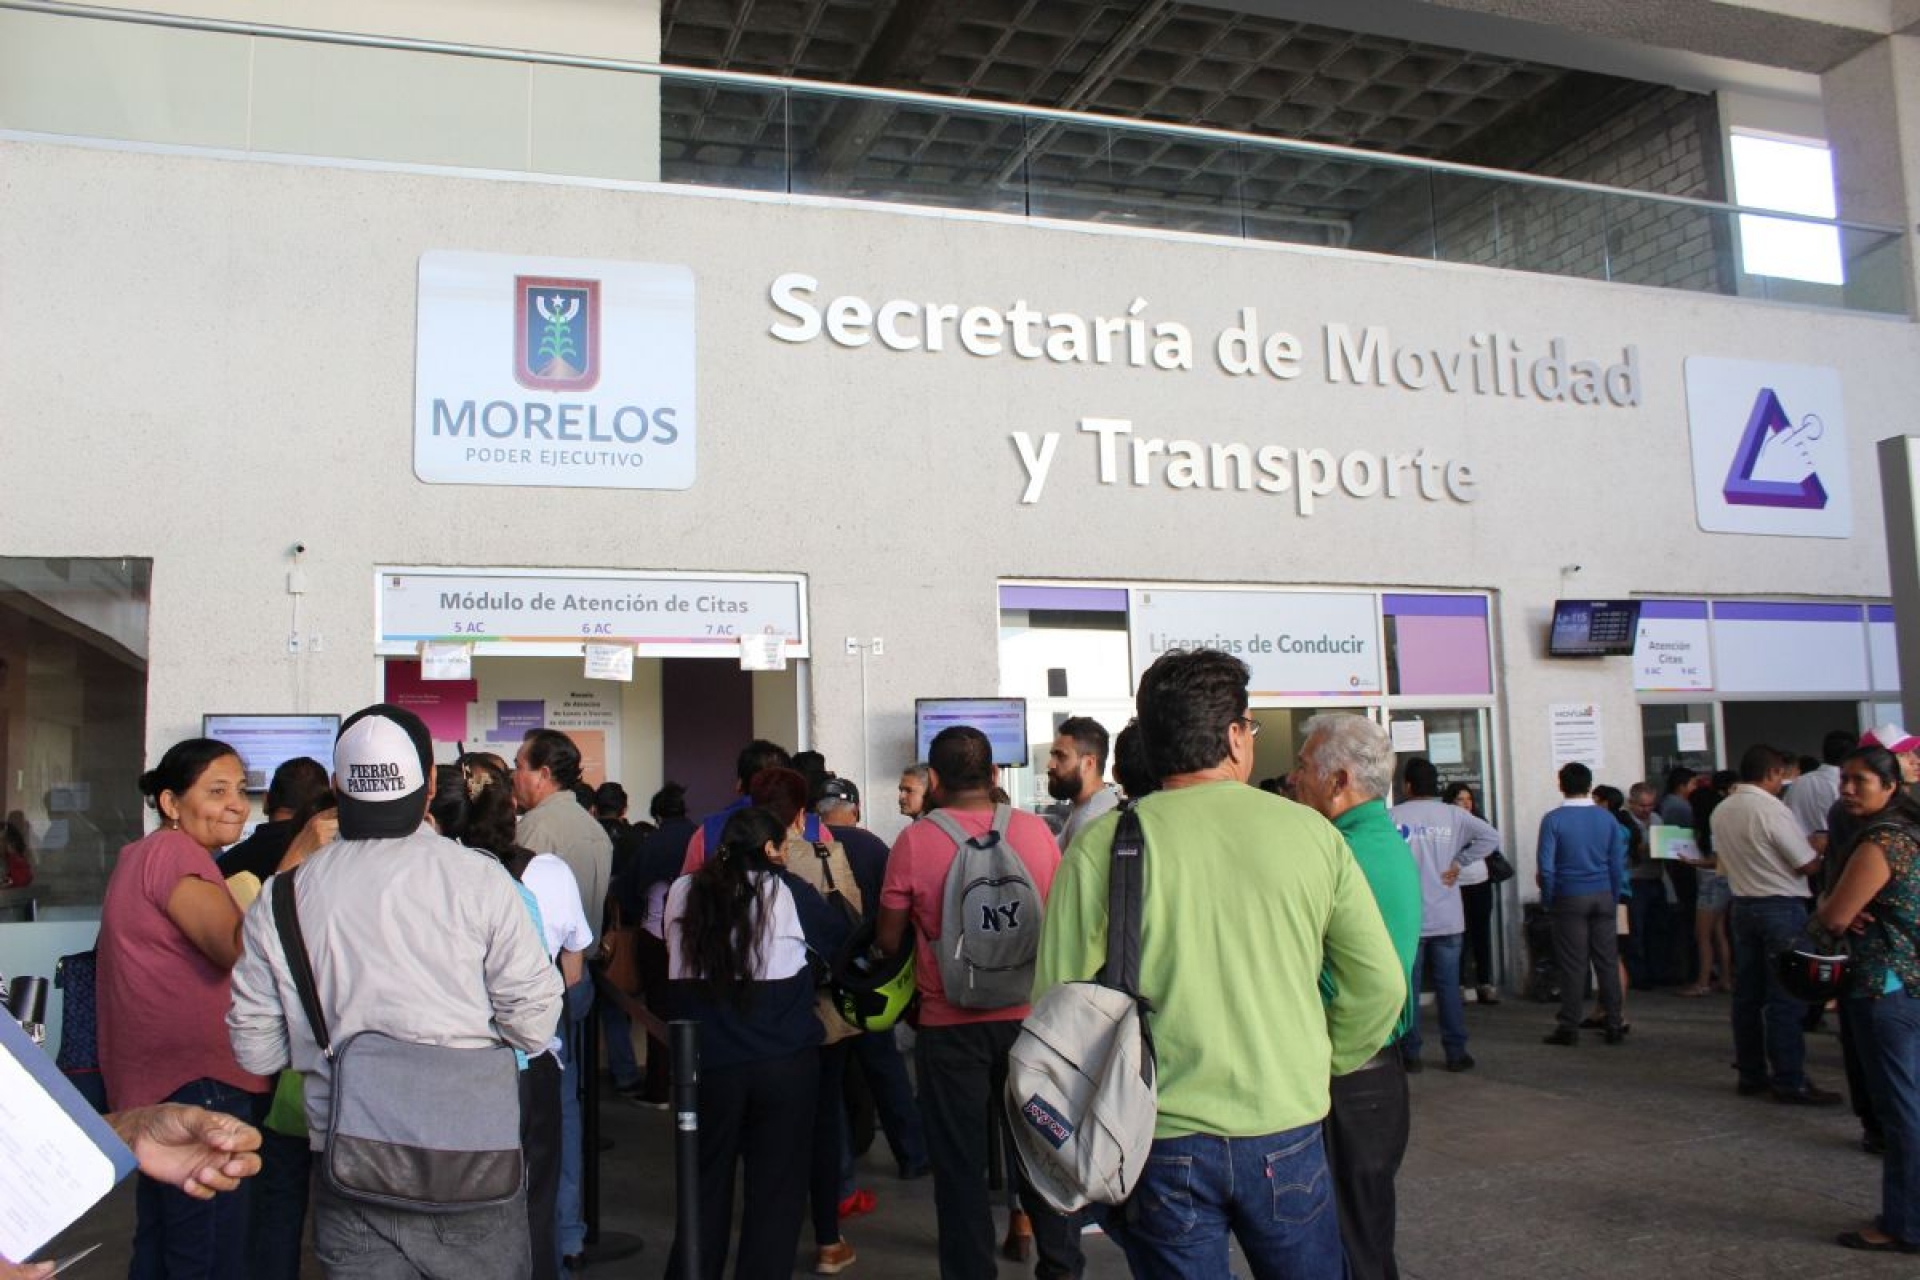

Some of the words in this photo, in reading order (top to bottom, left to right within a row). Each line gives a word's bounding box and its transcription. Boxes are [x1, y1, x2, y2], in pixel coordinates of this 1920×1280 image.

[770, 273, 1193, 370] Secretaría
[1217, 307, 1303, 379] de
[1324, 322, 1643, 407] Movilidad
[432, 398, 679, 445] MORELOS
[466, 447, 531, 463] PODER
[540, 450, 644, 467] EJECUTIVO
[1010, 430, 1060, 504] y
[1080, 417, 1482, 516] Transporte
[439, 592, 524, 611] Módulo
[530, 592, 556, 611] de
[563, 593, 659, 612] Atención
[665, 594, 690, 612] de
[696, 596, 749, 613] Citas
[454, 621, 462, 633] 5
[466, 621, 485, 633] AC
[582, 623, 591, 634] 6
[594, 623, 612, 634] AC
[706, 625, 713, 635] 7
[716, 625, 734, 635] AC
[1149, 633, 1243, 653] Licencias
[1247, 633, 1272, 653] de
[1277, 633, 1366, 654] Conducir
[1648, 640, 1691, 651] Atención
[1659, 653, 1683, 664] Citas
[349, 763, 399, 778] FIERRO
[347, 776, 406, 793] PARIENTE
[981, 900, 1020, 932] NY
